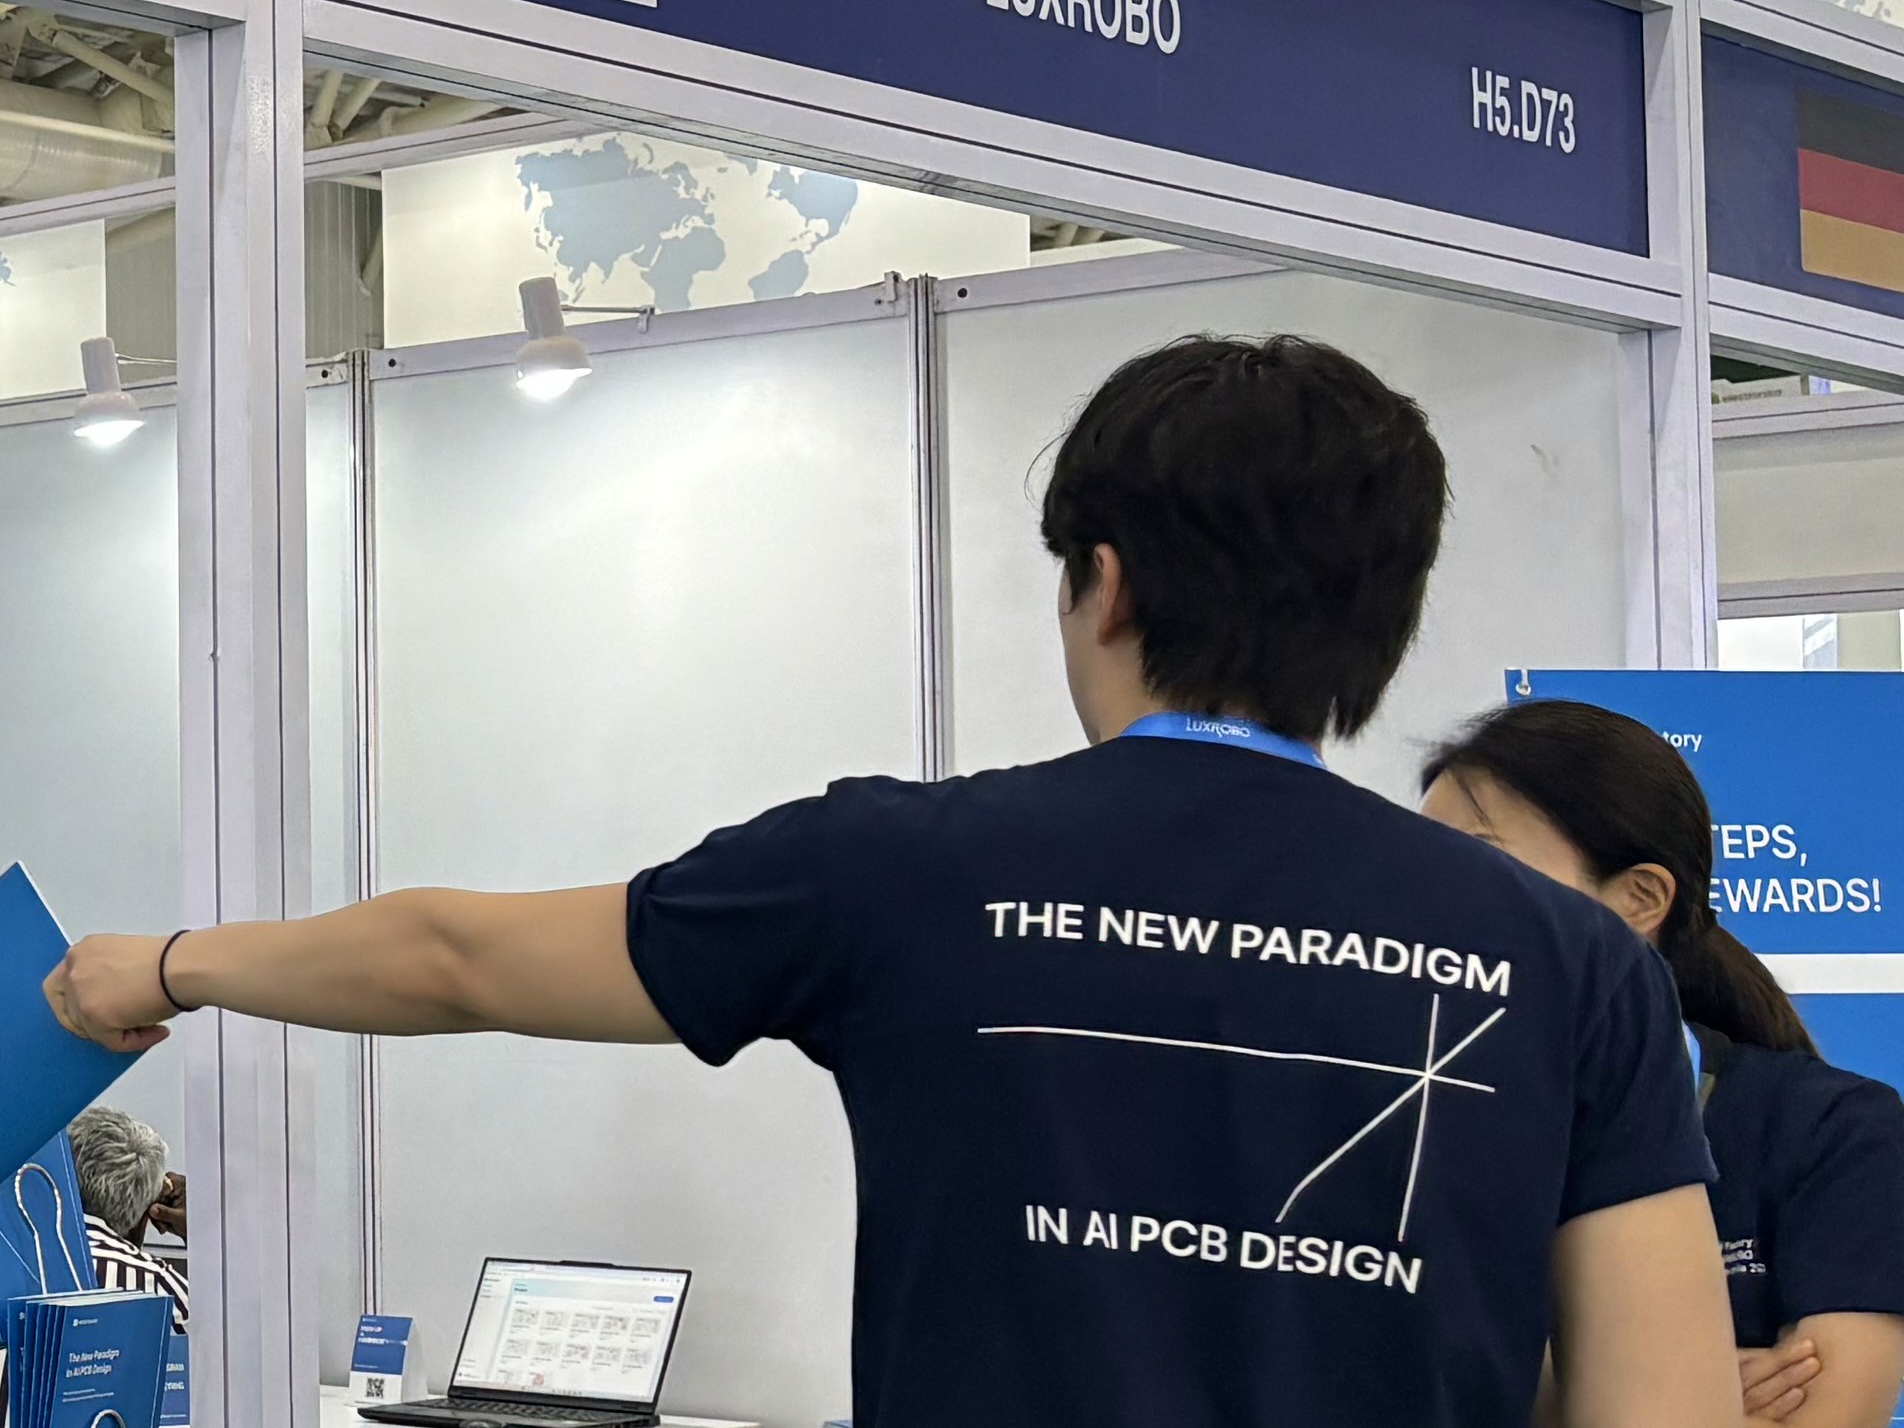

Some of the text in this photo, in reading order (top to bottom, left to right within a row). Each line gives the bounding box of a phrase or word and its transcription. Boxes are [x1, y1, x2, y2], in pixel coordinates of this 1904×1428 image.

[1470, 64, 1577, 154] H5.D73
[985, 901, 1512, 997] THE NEW PARADIGM
[1024, 1205, 1423, 1295] IN AI PCB DESIGN
